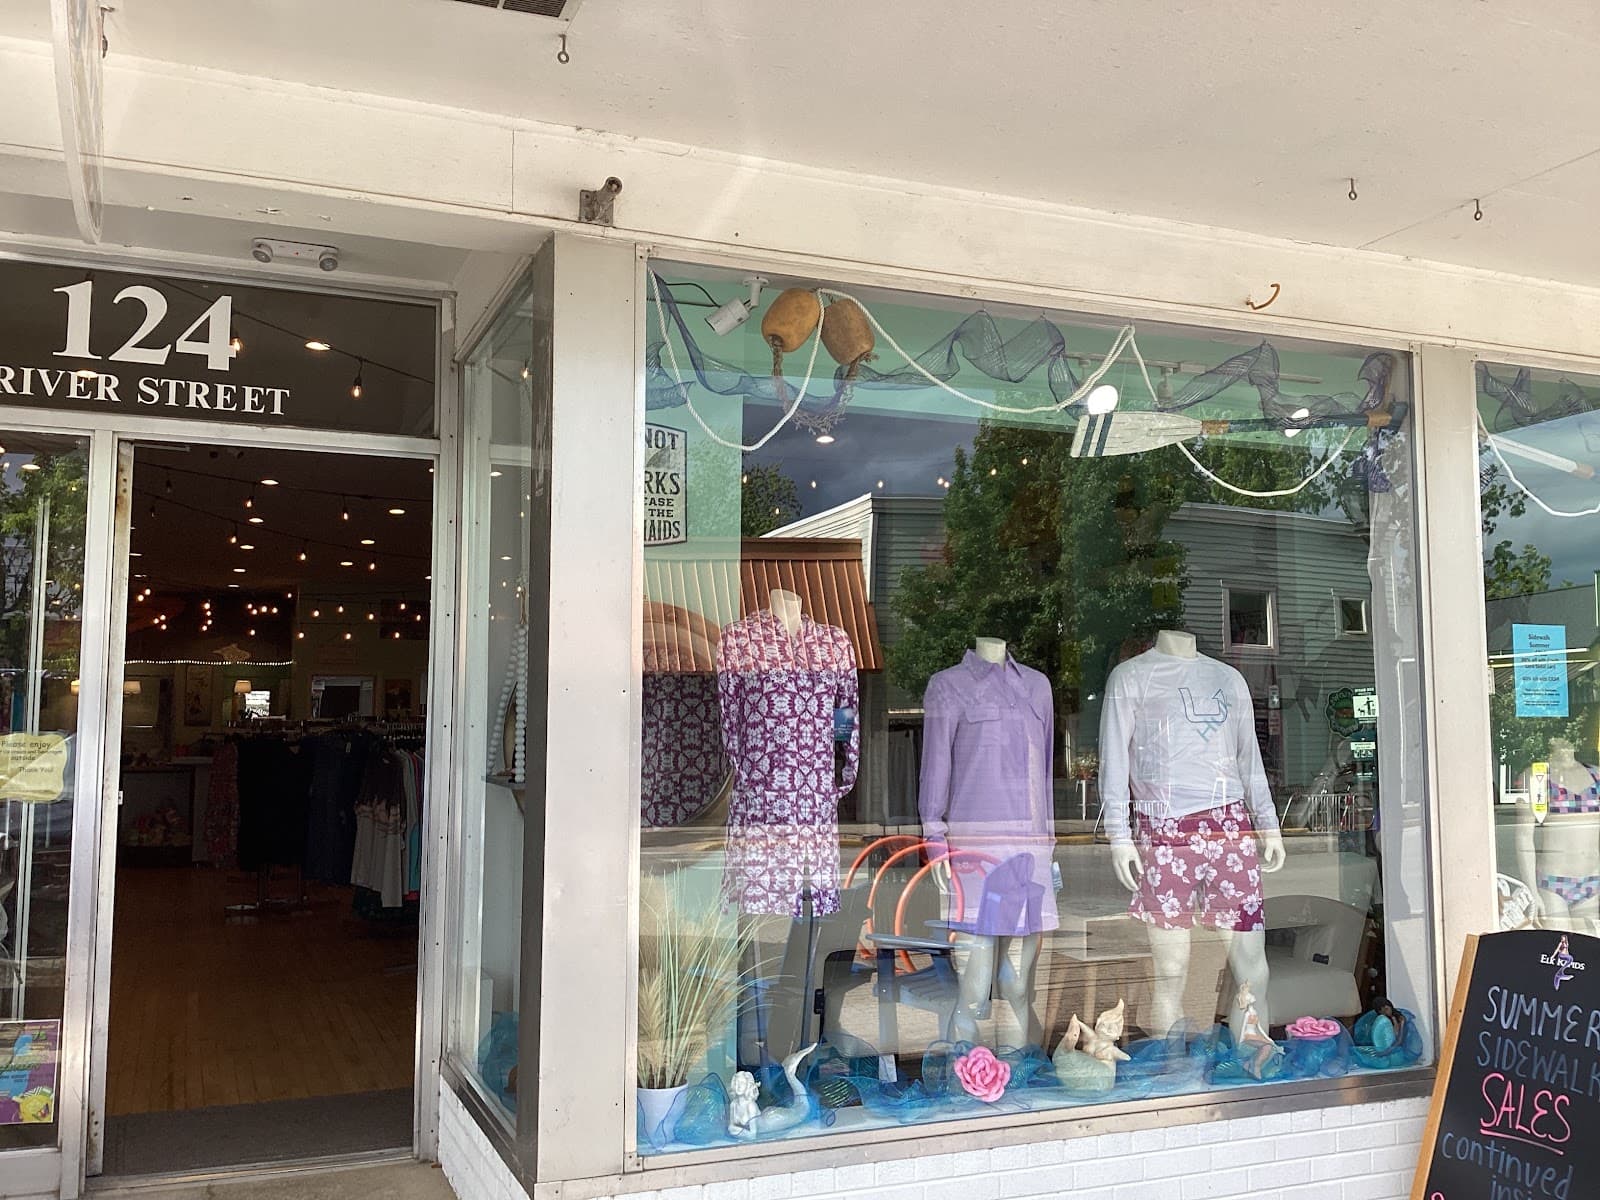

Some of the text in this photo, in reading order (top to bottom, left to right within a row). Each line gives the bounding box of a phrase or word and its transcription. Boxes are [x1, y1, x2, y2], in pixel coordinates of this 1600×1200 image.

[52, 280, 237, 371] 124
[0, 366, 290, 415] RIVER STREET
[648, 508, 674, 517] THE
[1557, 957, 1585, 970] RIDS
[1483, 986, 1600, 1050] SUMMER
[1480, 1072, 1570, 1143] SALES
[1442, 1132, 1573, 1200] continued
